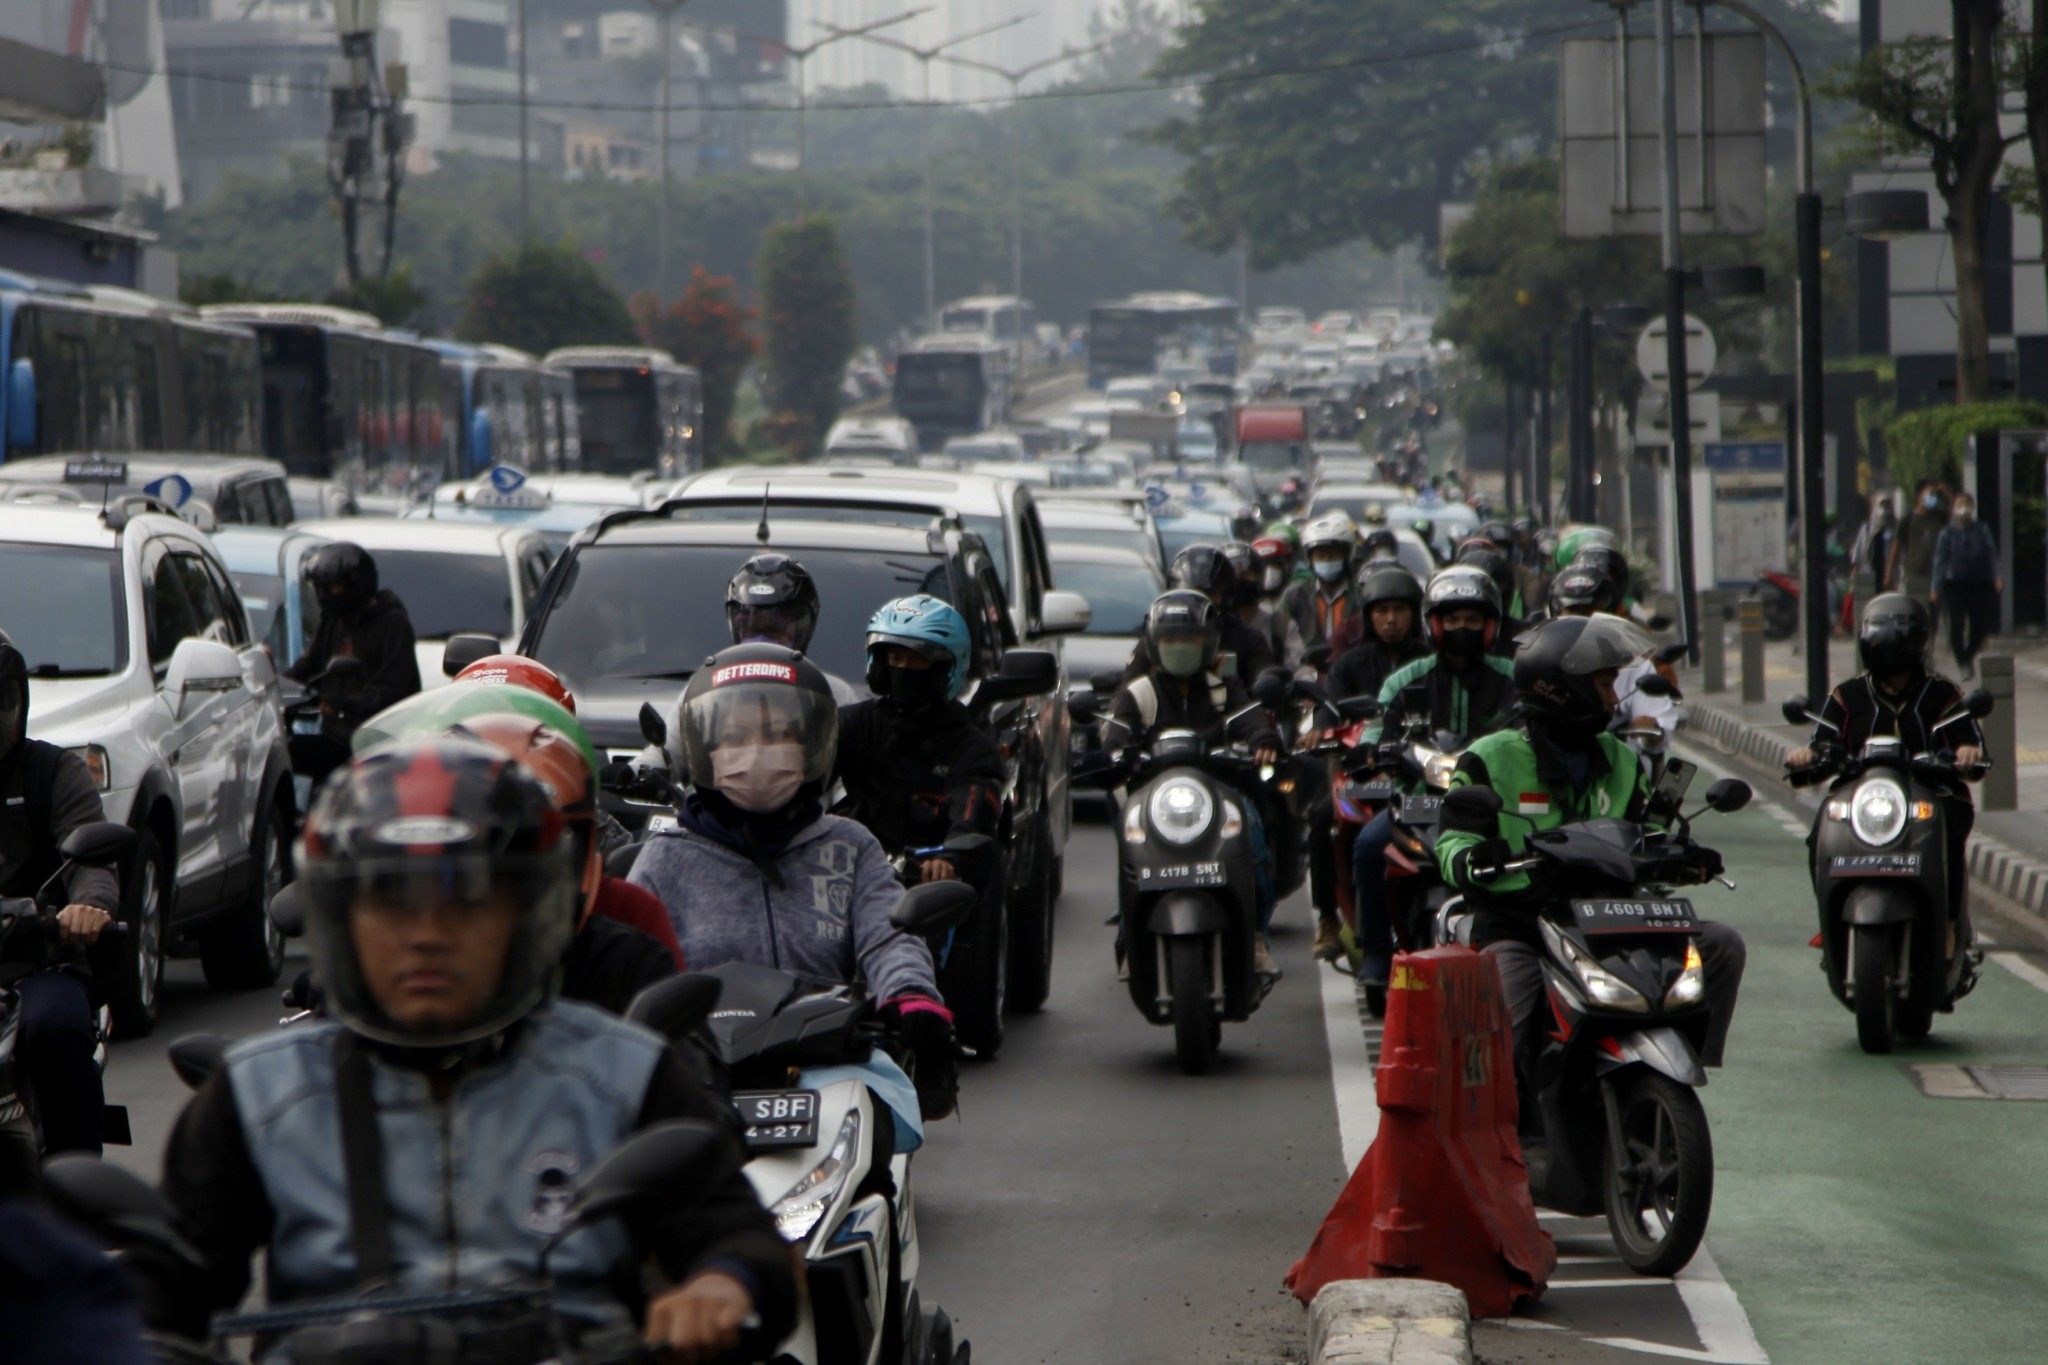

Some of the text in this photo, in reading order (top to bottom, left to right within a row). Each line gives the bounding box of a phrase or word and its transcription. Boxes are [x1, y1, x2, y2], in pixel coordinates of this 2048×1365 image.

[472, 669, 508, 679] Shopee
[1142, 864, 1219, 879] B 4178 SNT
[1583, 903, 1683, 917] B 4609 BNT
[755, 1098, 807, 1119] SBF
